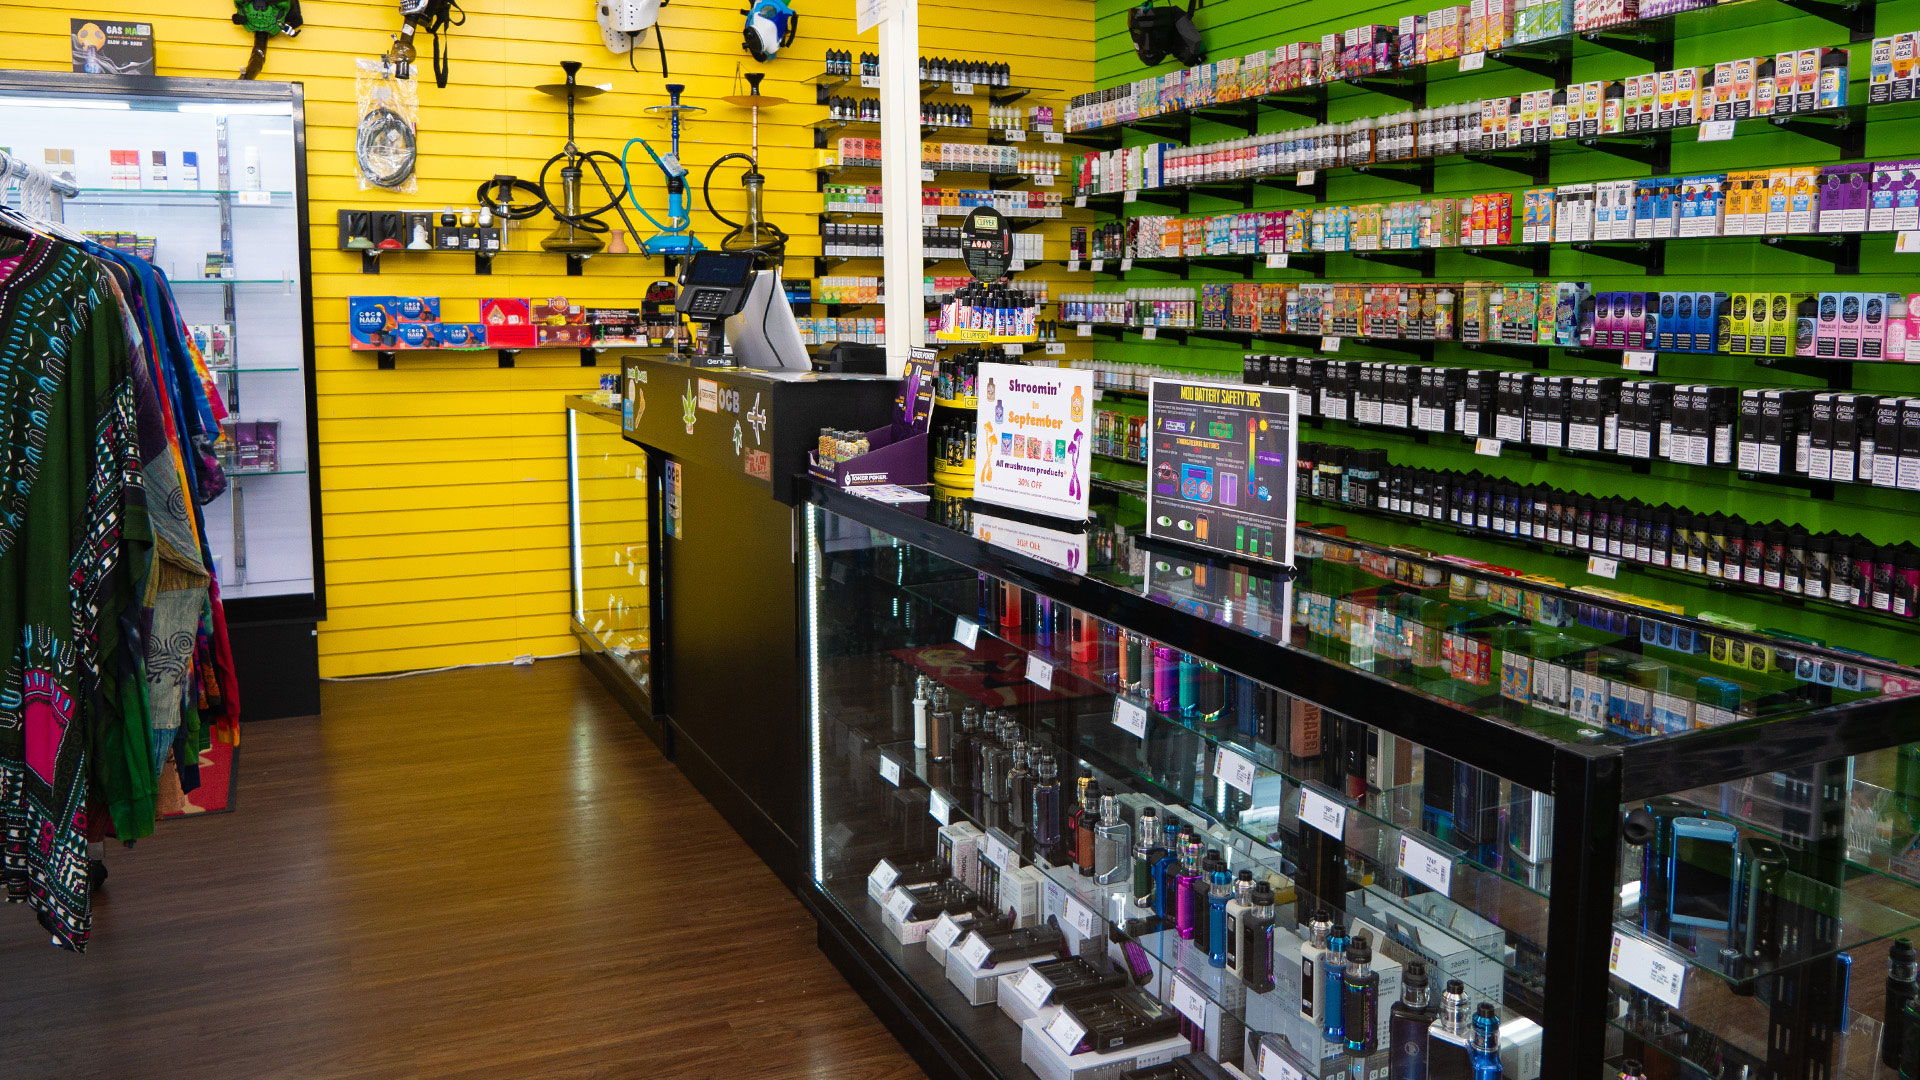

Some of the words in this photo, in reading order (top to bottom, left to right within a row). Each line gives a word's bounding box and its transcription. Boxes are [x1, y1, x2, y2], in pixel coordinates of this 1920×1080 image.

[976, 218, 997, 227] CLIPPER
[962, 331, 986, 339] CLIPPER
[707, 358, 731, 366] Genius
[1009, 379, 1061, 396] Shroomin'
[718, 388, 739, 413] OCB
[1181, 386, 1194, 401] MOD
[1195, 388, 1221, 403] BATTERY
[1221, 390, 1245, 405] SAFETY
[1246, 392, 1261, 408] TIPS
[1877, 409, 1897, 417] Coastal
[1008, 411, 1063, 430] September
[1878, 416, 1896, 424] Clouds
[1005, 462, 1036, 473] mushroom
[1018, 478, 1030, 487] 30%
[1031, 480, 1043, 489] OFF
